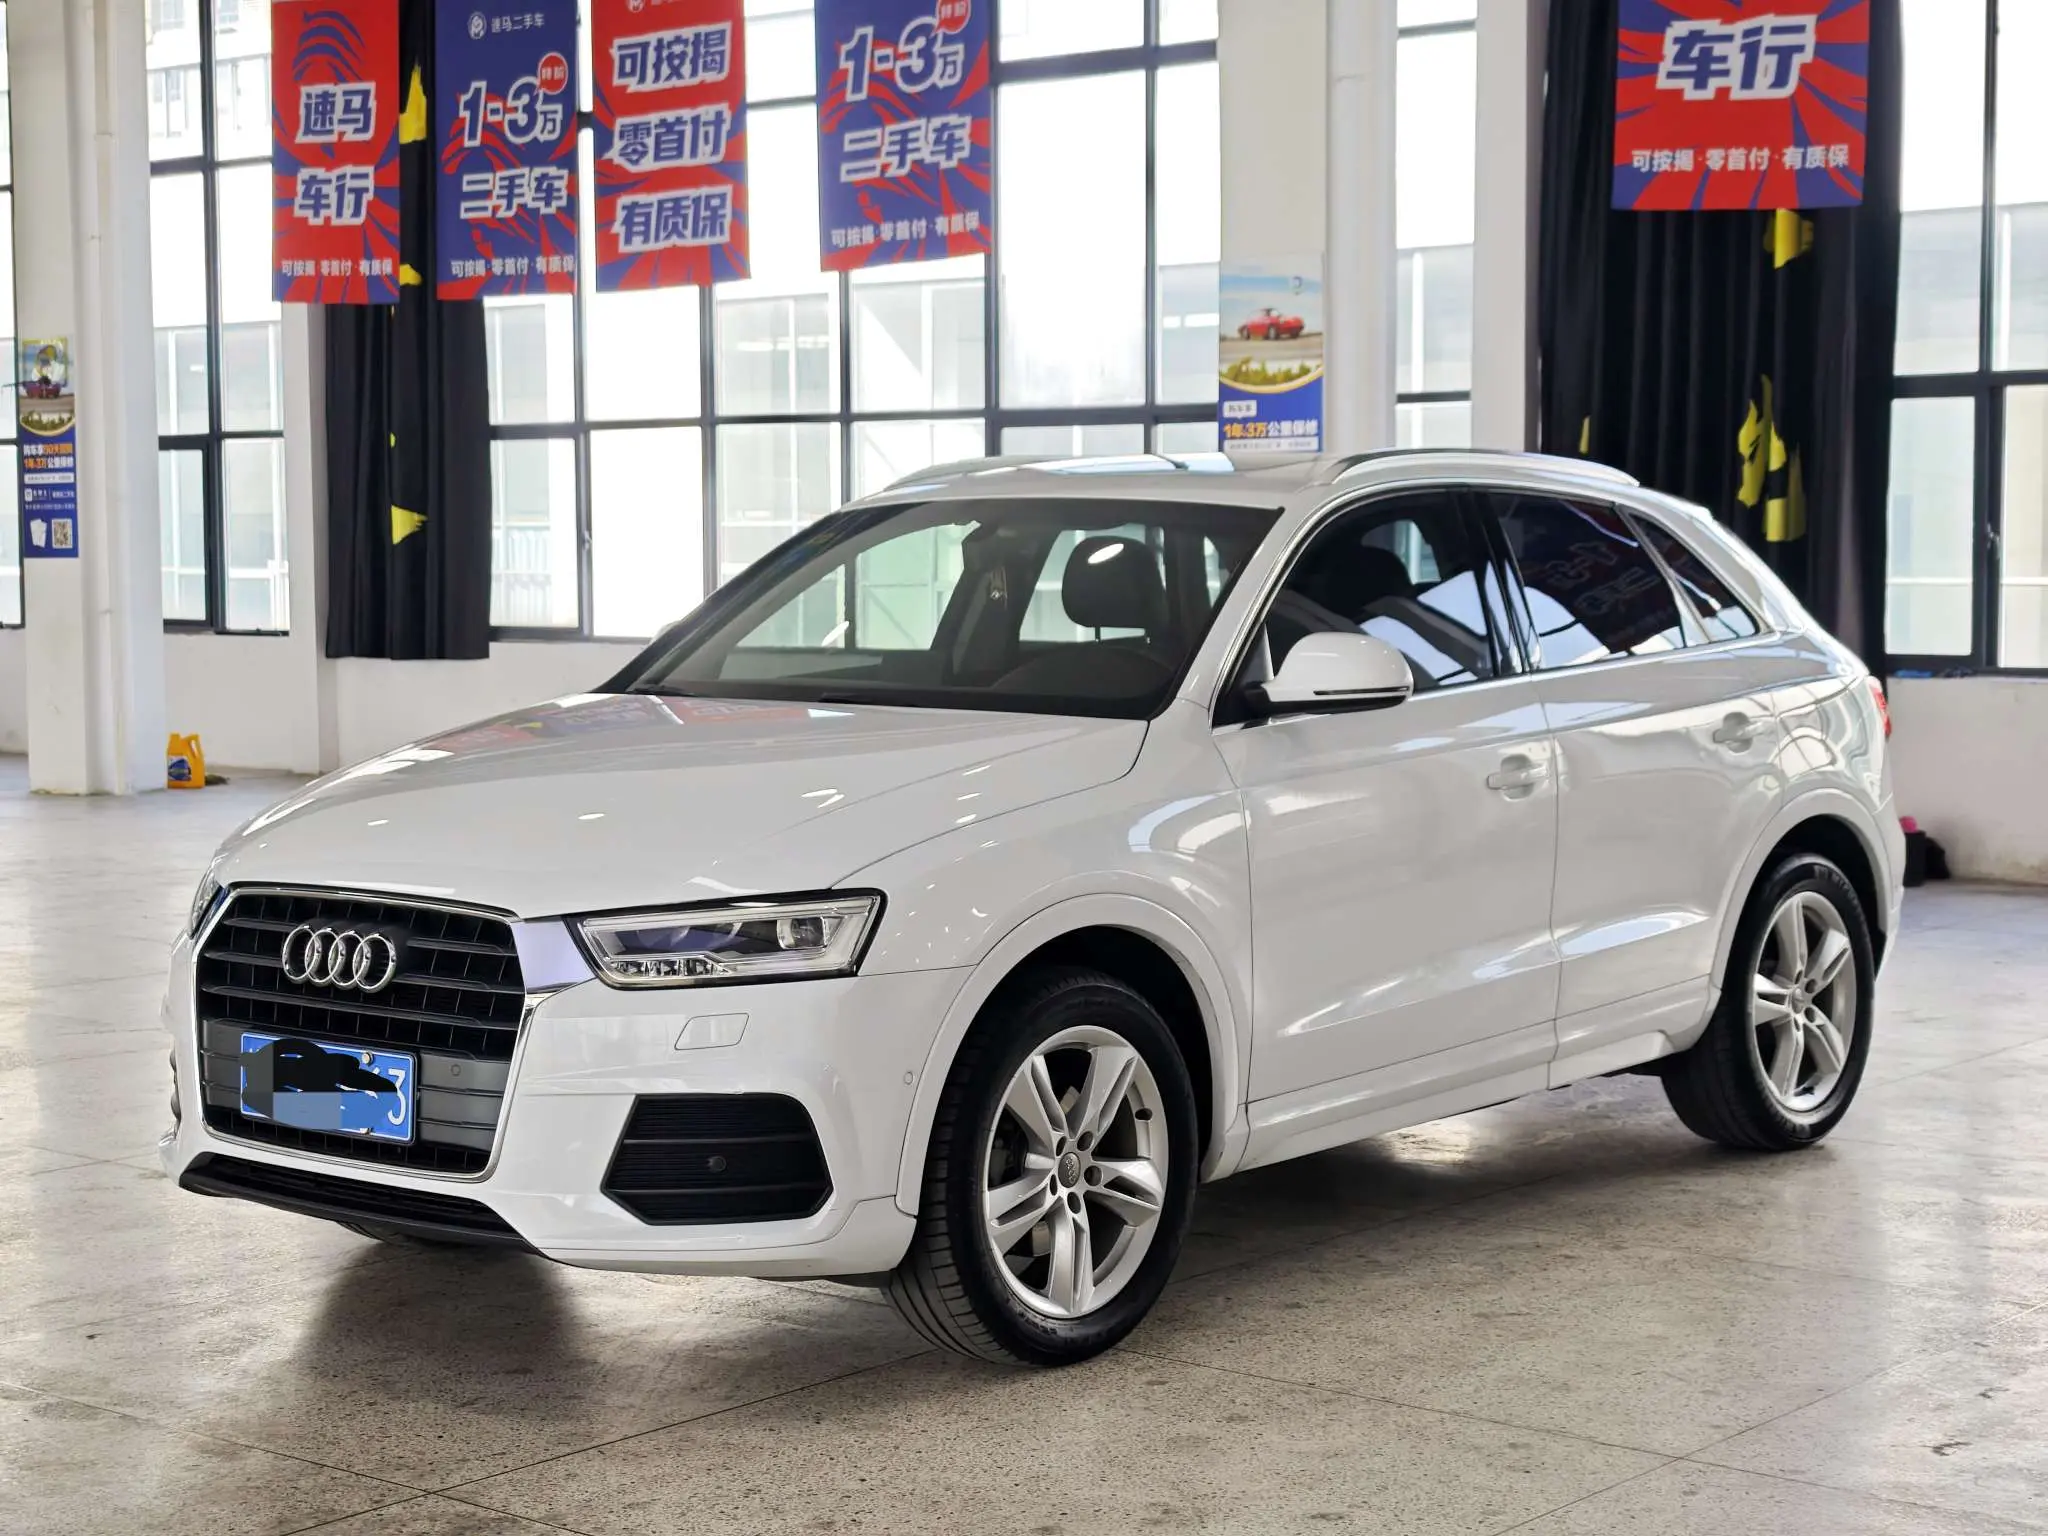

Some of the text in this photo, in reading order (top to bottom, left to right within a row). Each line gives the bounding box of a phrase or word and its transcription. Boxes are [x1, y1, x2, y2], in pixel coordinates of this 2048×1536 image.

[613, 23, 732, 92] 可按揭
[1656, 14, 1817, 100] 车行
[295, 82, 376, 143] 速马
[606, 103, 731, 172] 零首付
[840, 114, 972, 182] 二手车
[294, 165, 374, 225] 车行
[460, 166, 568, 219] 二手车
[611, 185, 732, 253] 有质保
